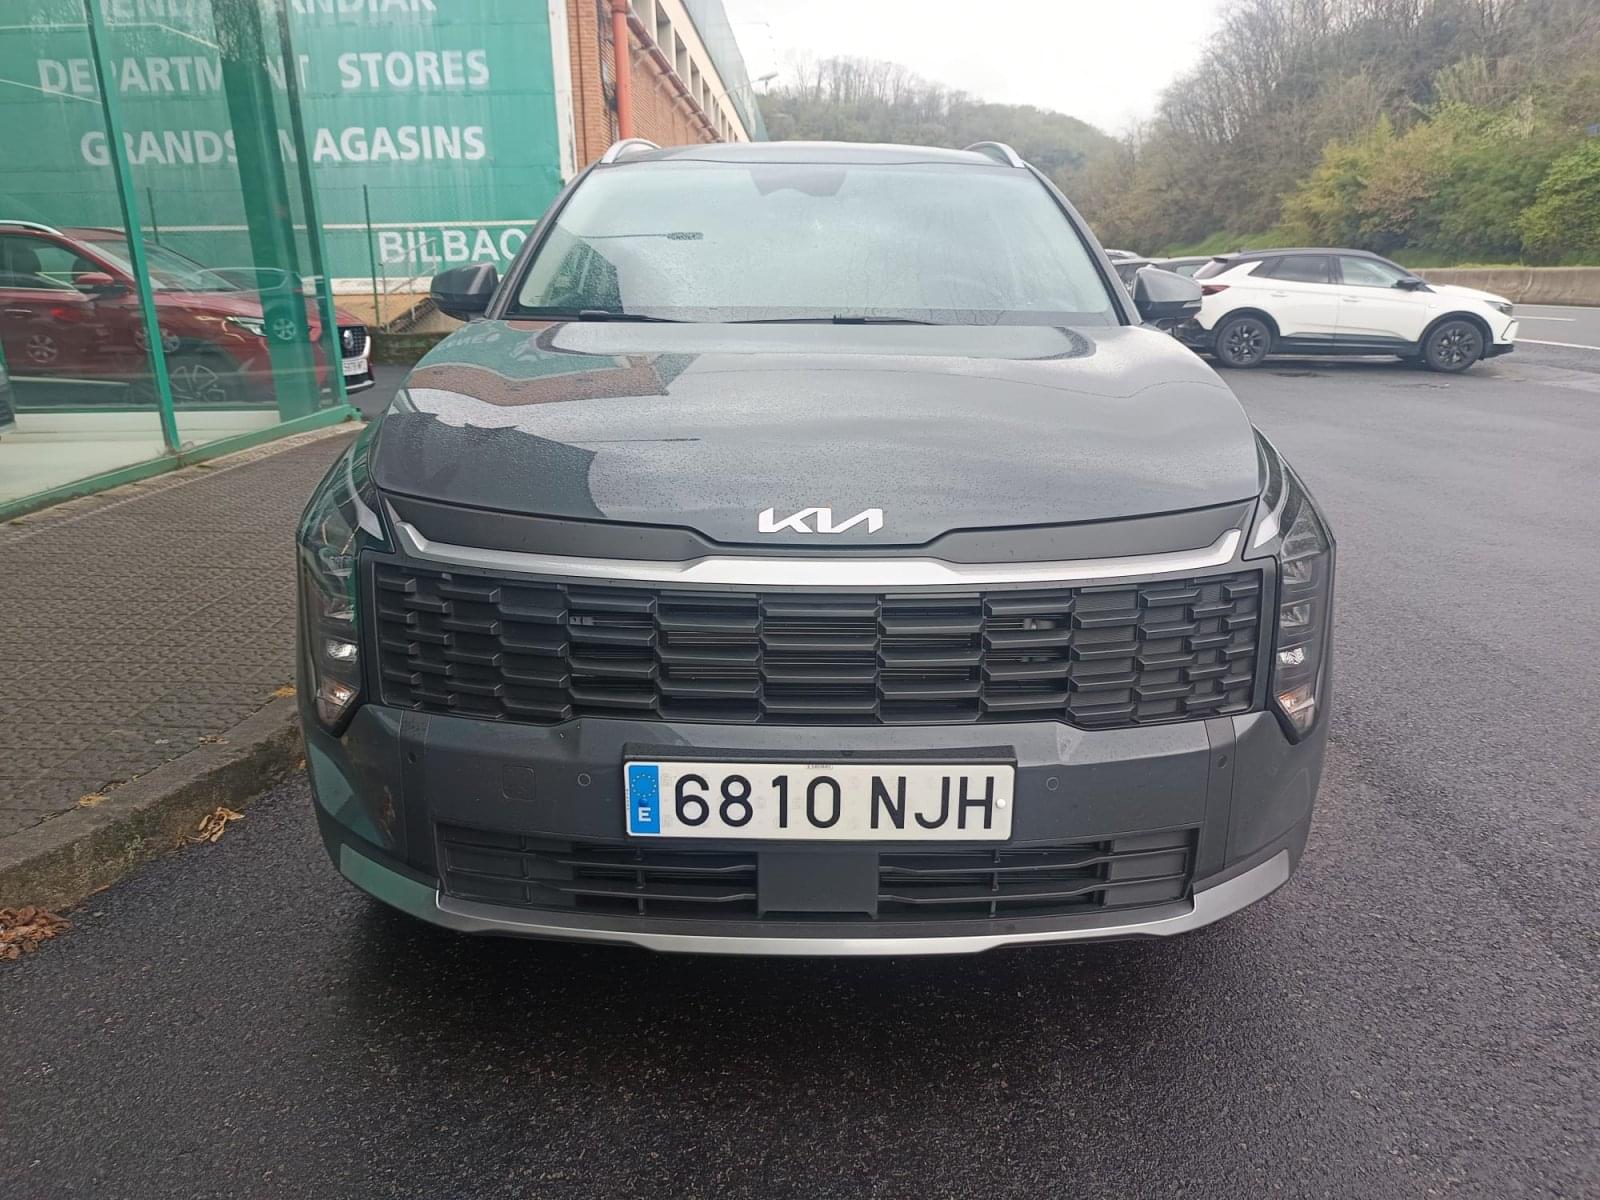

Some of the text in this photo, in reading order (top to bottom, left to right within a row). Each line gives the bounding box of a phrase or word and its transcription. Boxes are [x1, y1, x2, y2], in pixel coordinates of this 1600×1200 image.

[37, 49, 490, 92] DEARTMN STORES
[378, 228, 528, 263] BILBAO
[758, 507, 883, 534] KIA
[638, 806, 652, 822] E
[674, 773, 995, 830] 6810 NJH
